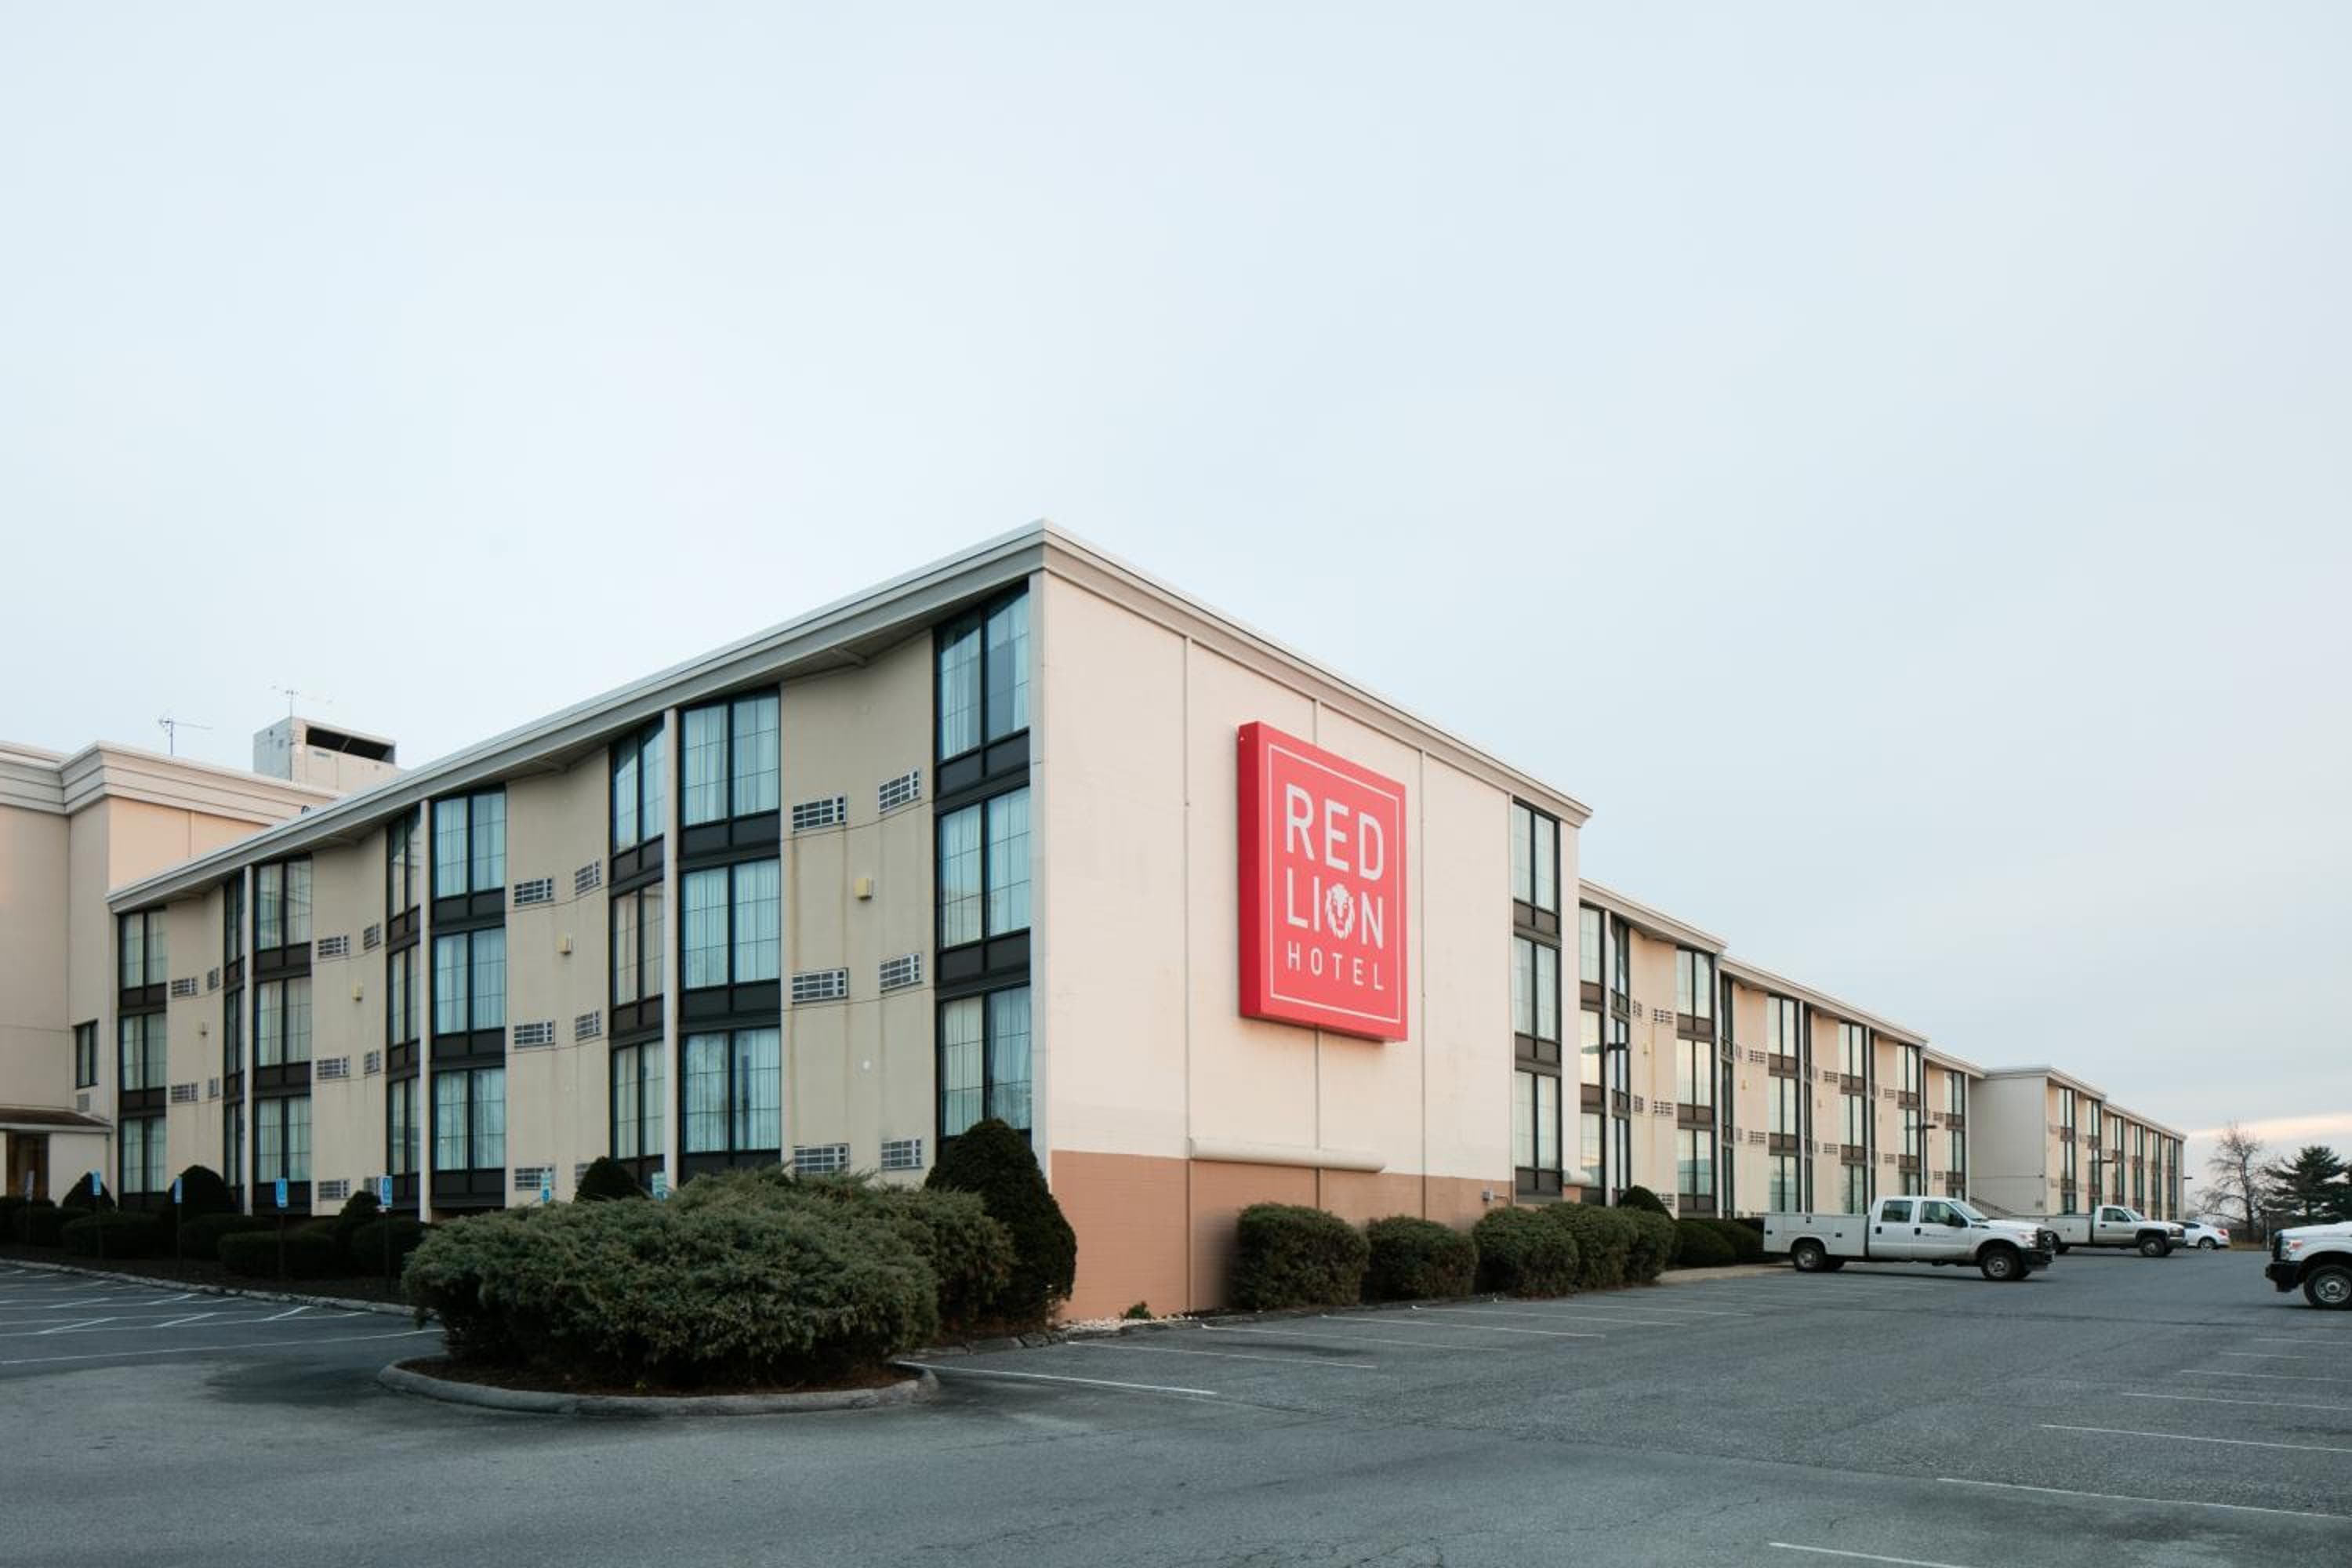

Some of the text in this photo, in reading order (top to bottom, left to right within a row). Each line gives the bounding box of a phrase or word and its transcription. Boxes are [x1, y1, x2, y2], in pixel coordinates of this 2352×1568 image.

[1286, 783, 1385, 881] RED
[1287, 867, 1384, 950] LION
[1287, 941, 1385, 990] HOTEL
